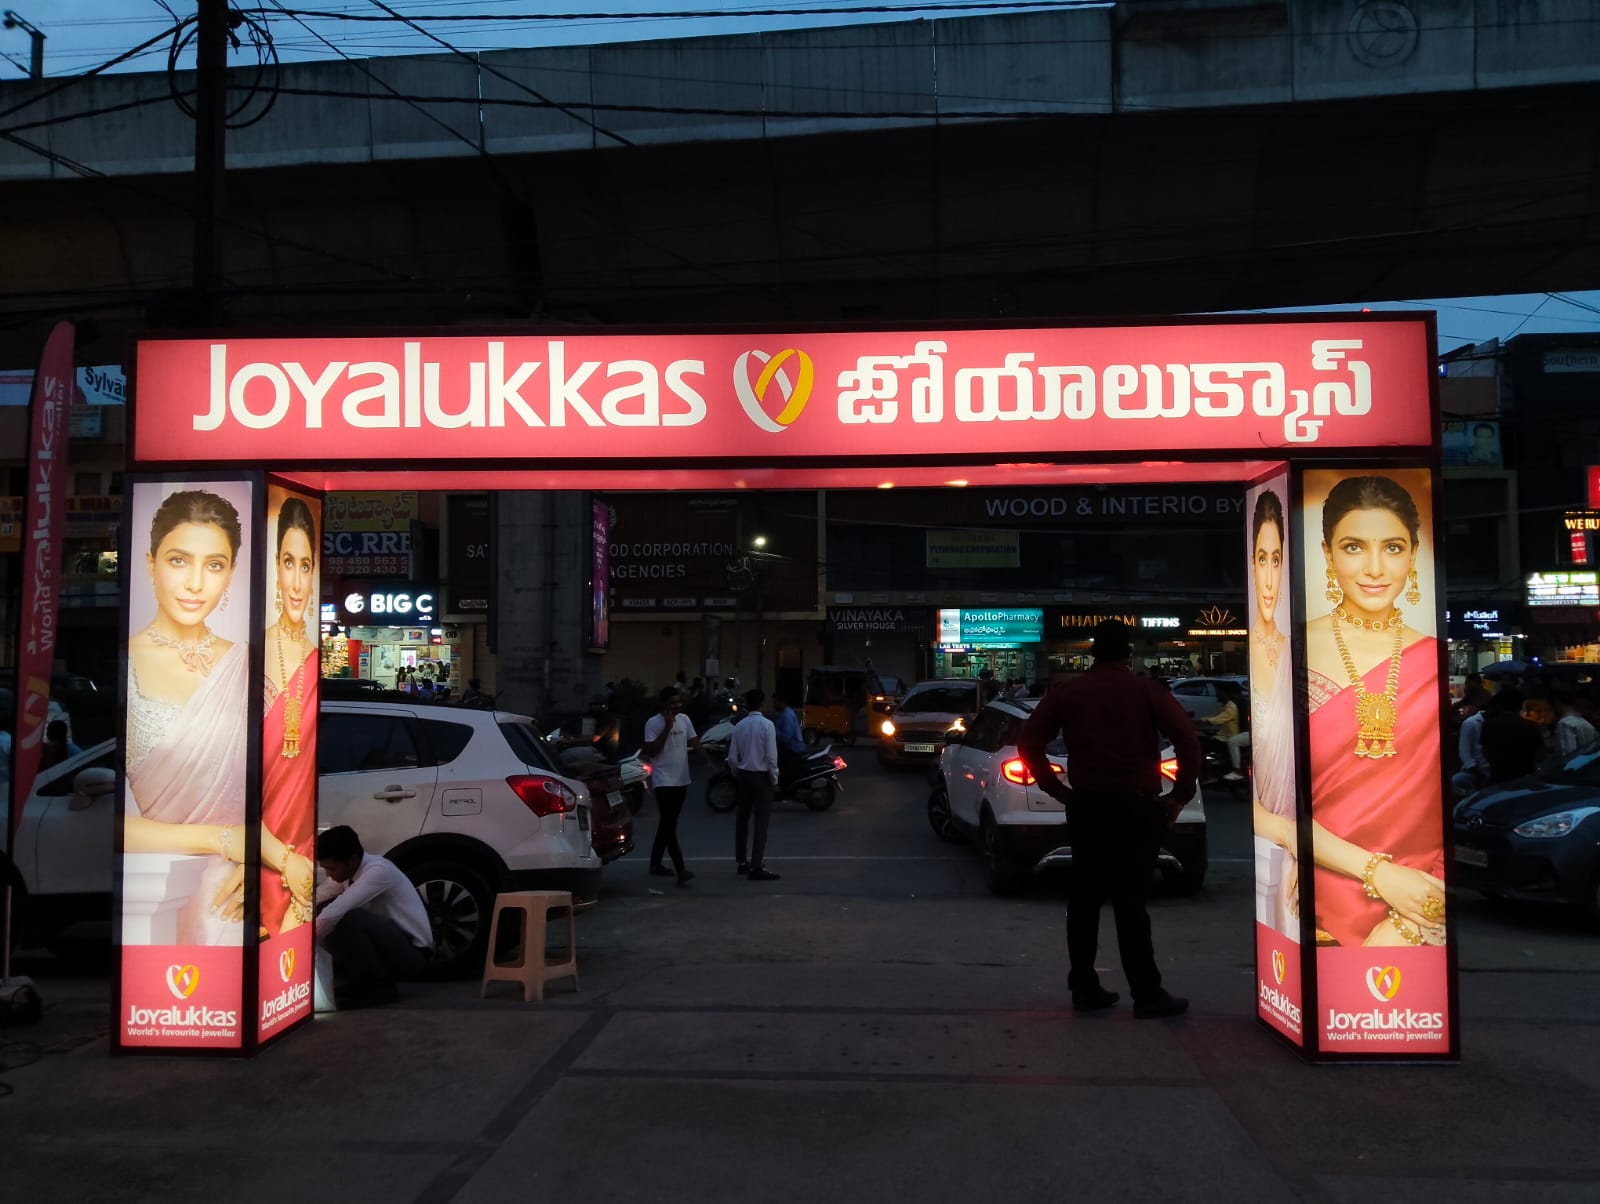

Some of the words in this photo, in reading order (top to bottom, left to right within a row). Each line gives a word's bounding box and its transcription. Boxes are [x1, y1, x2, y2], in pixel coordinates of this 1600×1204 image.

[193, 340, 706, 431] Joyalukkas
[837, 339, 1372, 443] జోయాలుక్కాస్
[985, 497, 1067, 518] WOOD
[1075, 496, 1094, 516] &
[1102, 495, 1208, 515] INTERIO
[1215, 498, 1244, 514] BY
[1585, 518, 1600, 529] BU
[466, 543, 488, 559] SA
[609, 543, 629, 558] OD
[633, 542, 733, 558] CORPORATION
[370, 593, 412, 614] BIG
[415, 593, 433, 614] C
[829, 608, 905, 622] VINAYAKA
[1141, 617, 1180, 628] TIFFINS
[835, 621, 865, 631] SILVER
[866, 621, 896, 631] HOUSE
[261, 980, 310, 1022] Joyalukkas
[1260, 979, 1301, 1024] Joyalukkas
[127, 1004, 237, 1027] Joyalukkas
[1326, 1008, 1443, 1030] Joyalukkas
[127, 1027, 161, 1037] World's
[161, 1027, 201, 1038] favourite
[201, 1028, 236, 1039] jeweller
[1327, 1031, 1362, 1041] World's
[1363, 1031, 1405, 1041] favourite
[1406, 1031, 1443, 1042] jeweller
